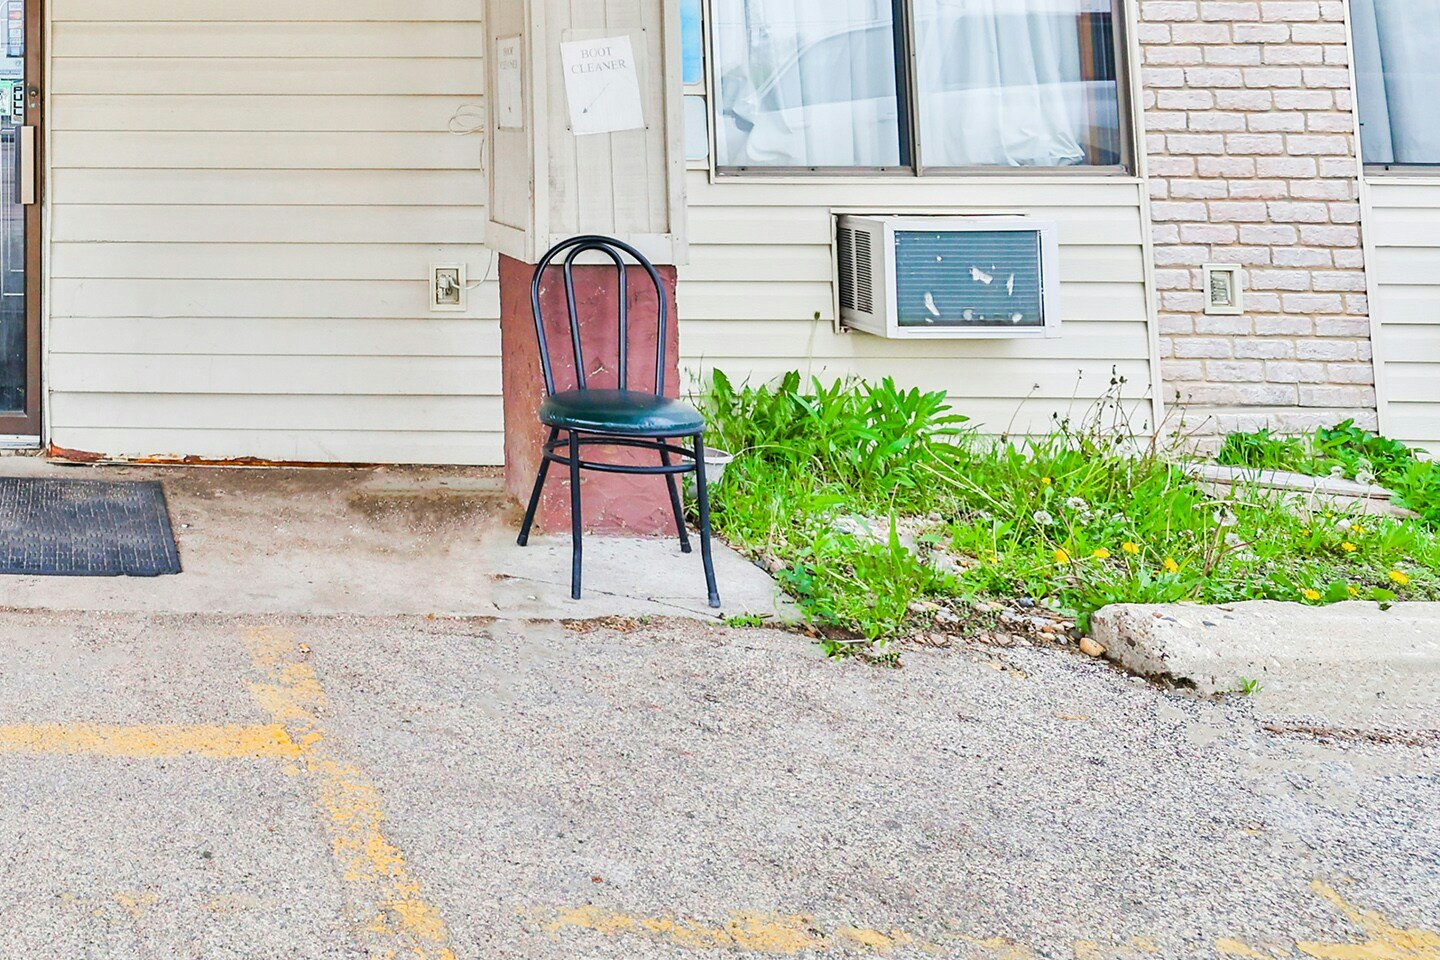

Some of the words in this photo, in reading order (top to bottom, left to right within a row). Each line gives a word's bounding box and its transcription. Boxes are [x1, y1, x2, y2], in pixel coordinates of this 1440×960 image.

[581, 46, 613, 59] BOOT
[571, 59, 628, 75] CLEANER
[13, 86, 23, 116] PULL
